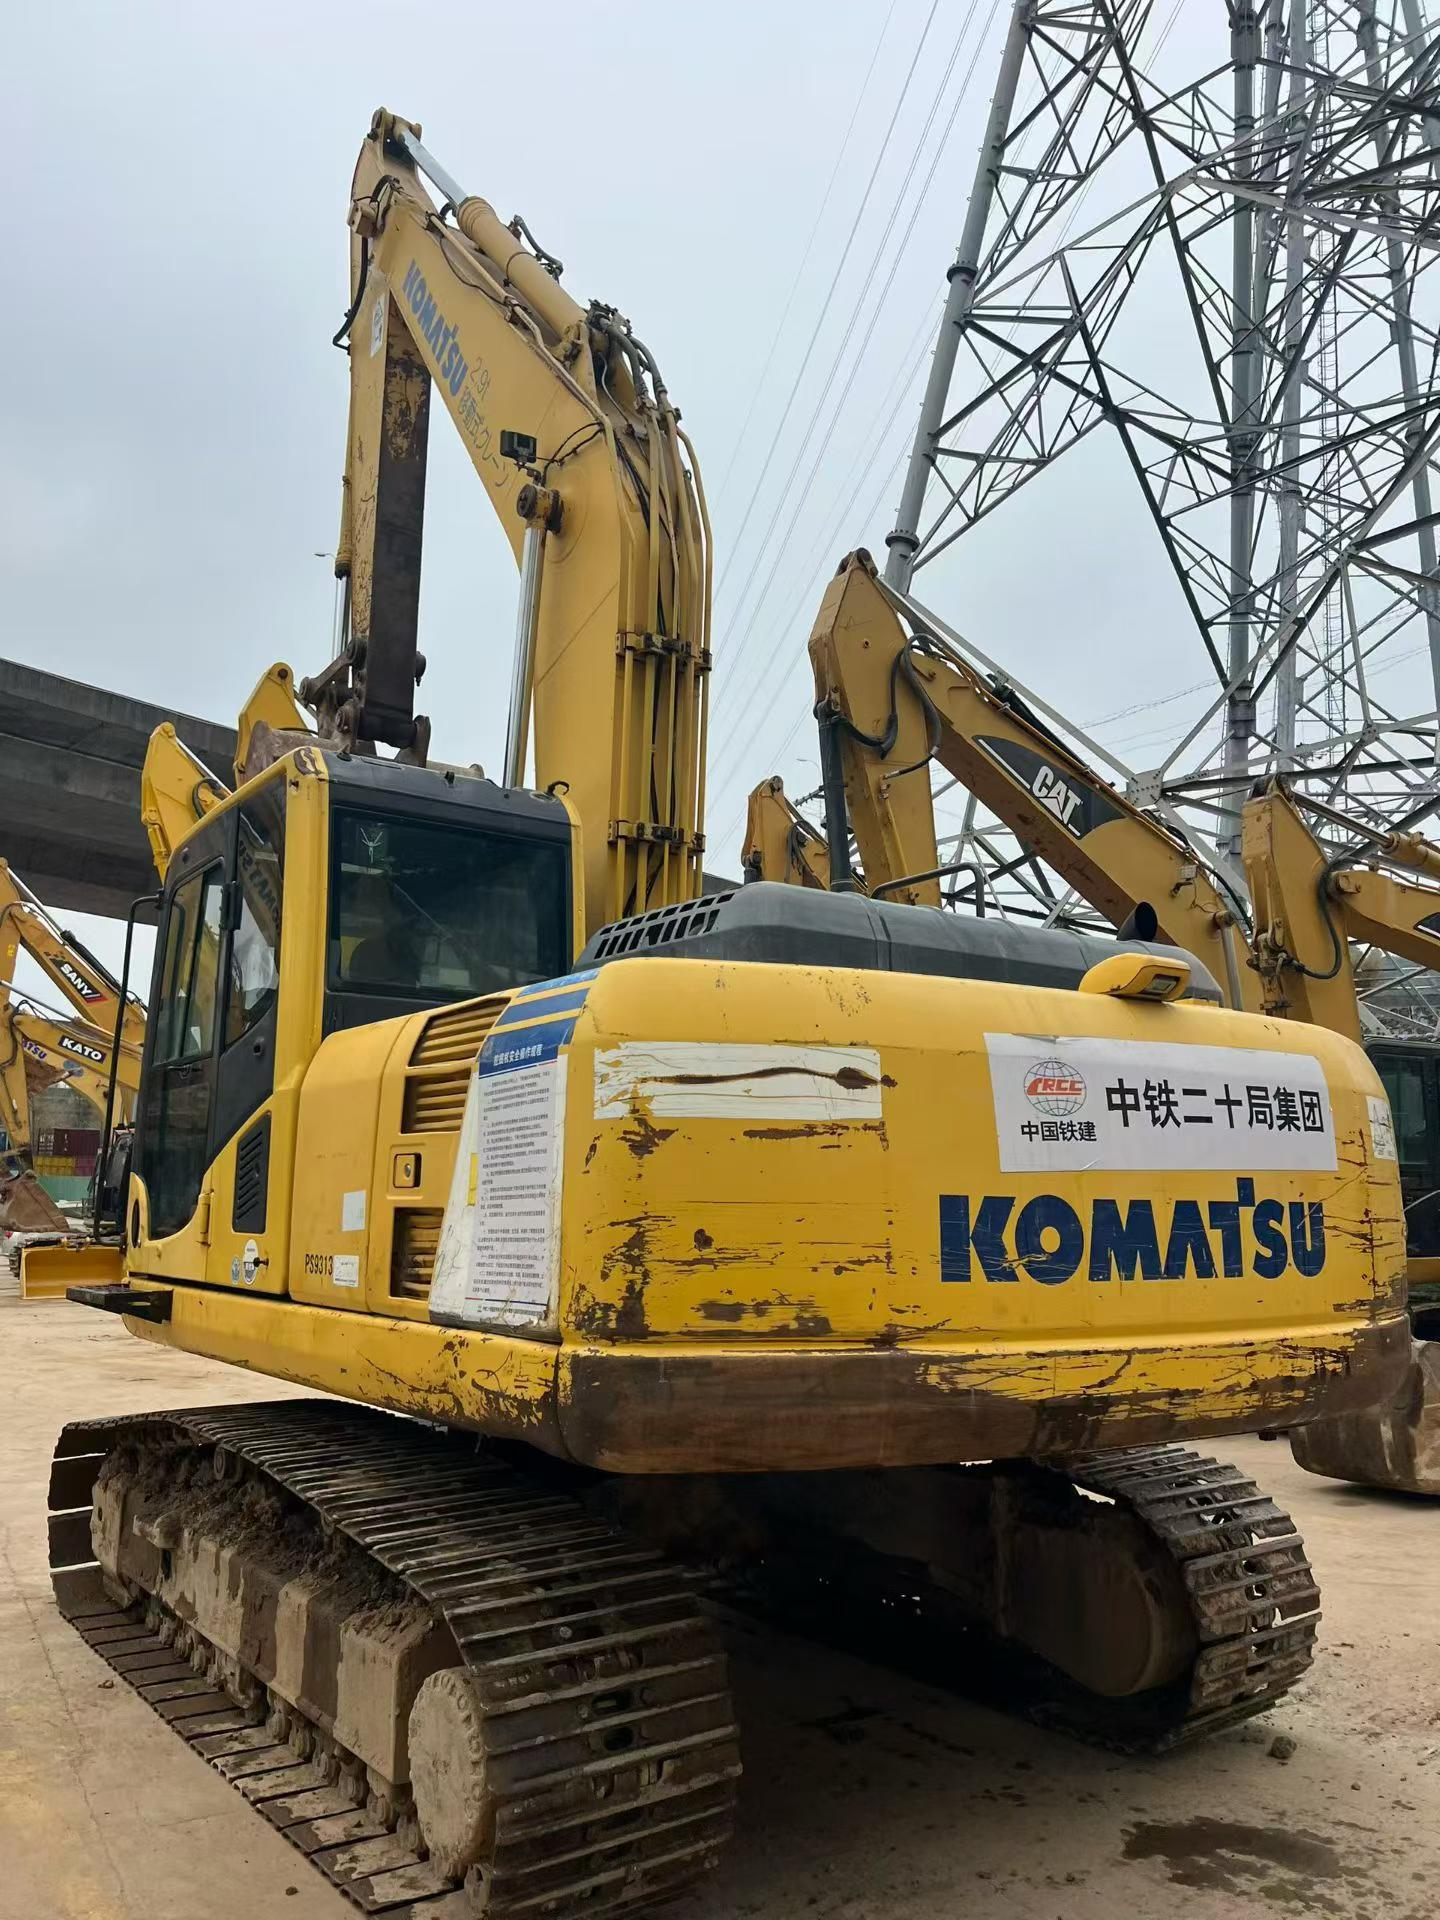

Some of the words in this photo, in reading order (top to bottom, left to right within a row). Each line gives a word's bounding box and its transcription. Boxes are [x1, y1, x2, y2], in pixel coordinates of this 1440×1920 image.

[402, 258, 469, 397] KOMATSU
[1032, 765, 1082, 824] CAT
[61, 963, 93, 996] SANY
[61, 1036, 104, 1060] KATO
[1026, 1076, 1084, 1096] CRCC
[1105, 1078, 1325, 1133] 中铁二十局集团
[1020, 1120, 1098, 1142] 中国铁建
[939, 1177, 1325, 1286] KOMATSU
[304, 1253, 333, 1276] PS9313
